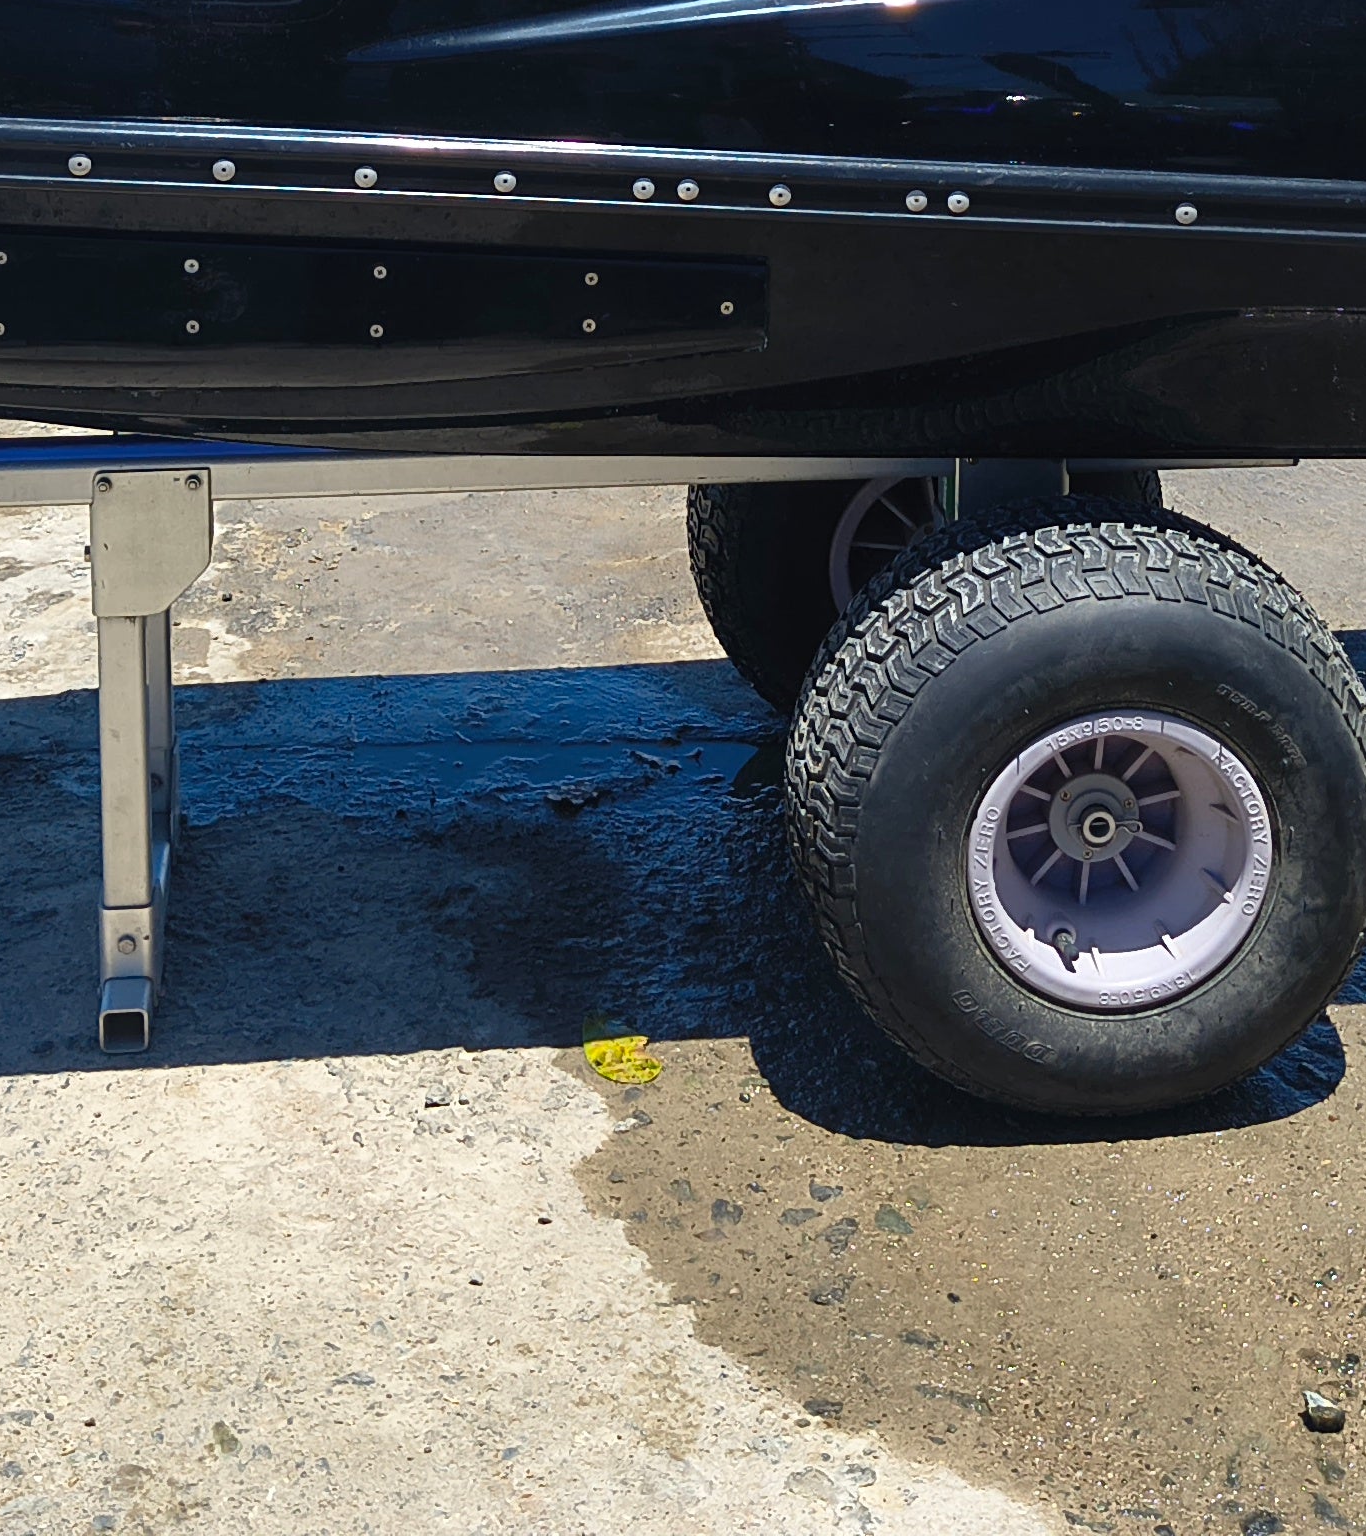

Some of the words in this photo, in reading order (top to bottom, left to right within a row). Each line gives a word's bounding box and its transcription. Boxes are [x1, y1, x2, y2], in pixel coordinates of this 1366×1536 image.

[973, 805, 1002, 870] ZERO
[1211, 746, 1268, 846] FACTORY
[1241, 852, 1267, 917] ZERO
[973, 878, 1032, 973] FACTORY
